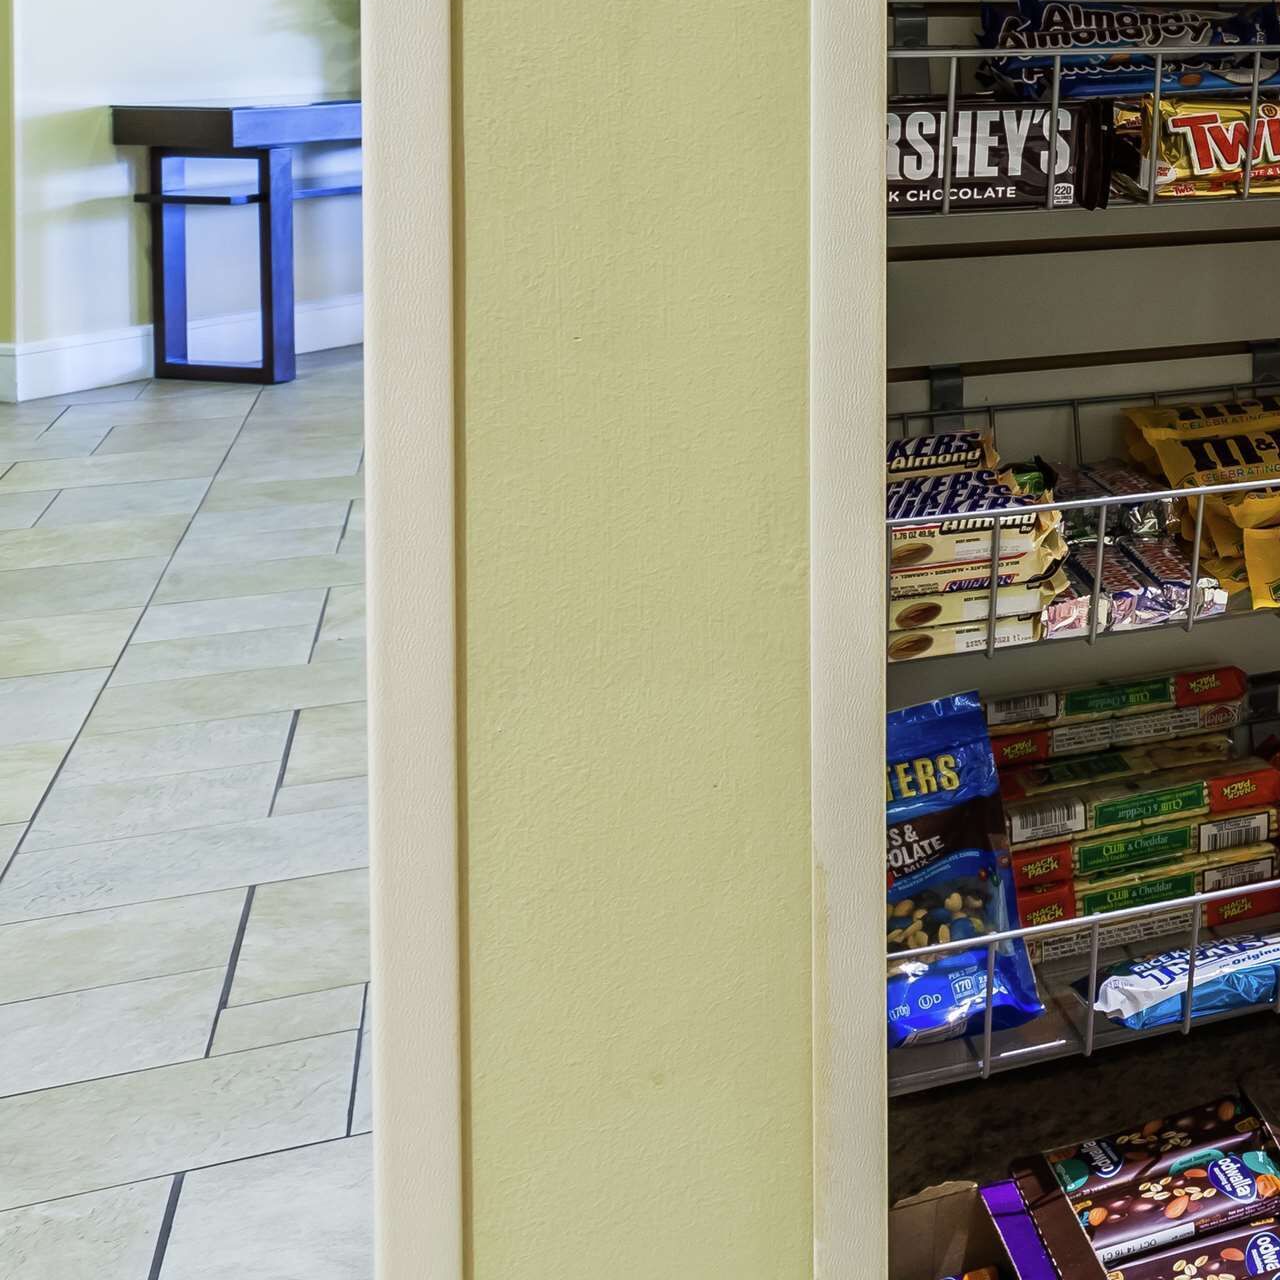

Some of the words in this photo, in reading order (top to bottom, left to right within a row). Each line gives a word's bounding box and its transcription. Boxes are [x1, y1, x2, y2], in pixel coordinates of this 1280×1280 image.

[887, 109, 1072, 179] RSHEY'S
[906, 186, 1017, 201] CHOCOLATE
[1055, 186, 1072, 195] 220
[886, 433, 980, 459] KERS
[890, 449, 981, 470] Almond
[1134, 835, 1169, 849] Cheddar
[887, 835, 944, 869] OLATE
[1021, 856, 1055, 873] SNACK
[1027, 862, 1059, 880] PACK
[1138, 882, 1173, 897] Cheddar
[1223, 903, 1253, 919] PACK
[1131, 950, 1171, 972] RICE
[954, 978, 972, 993] 170
[1218, 1157, 1250, 1198] odwalla
